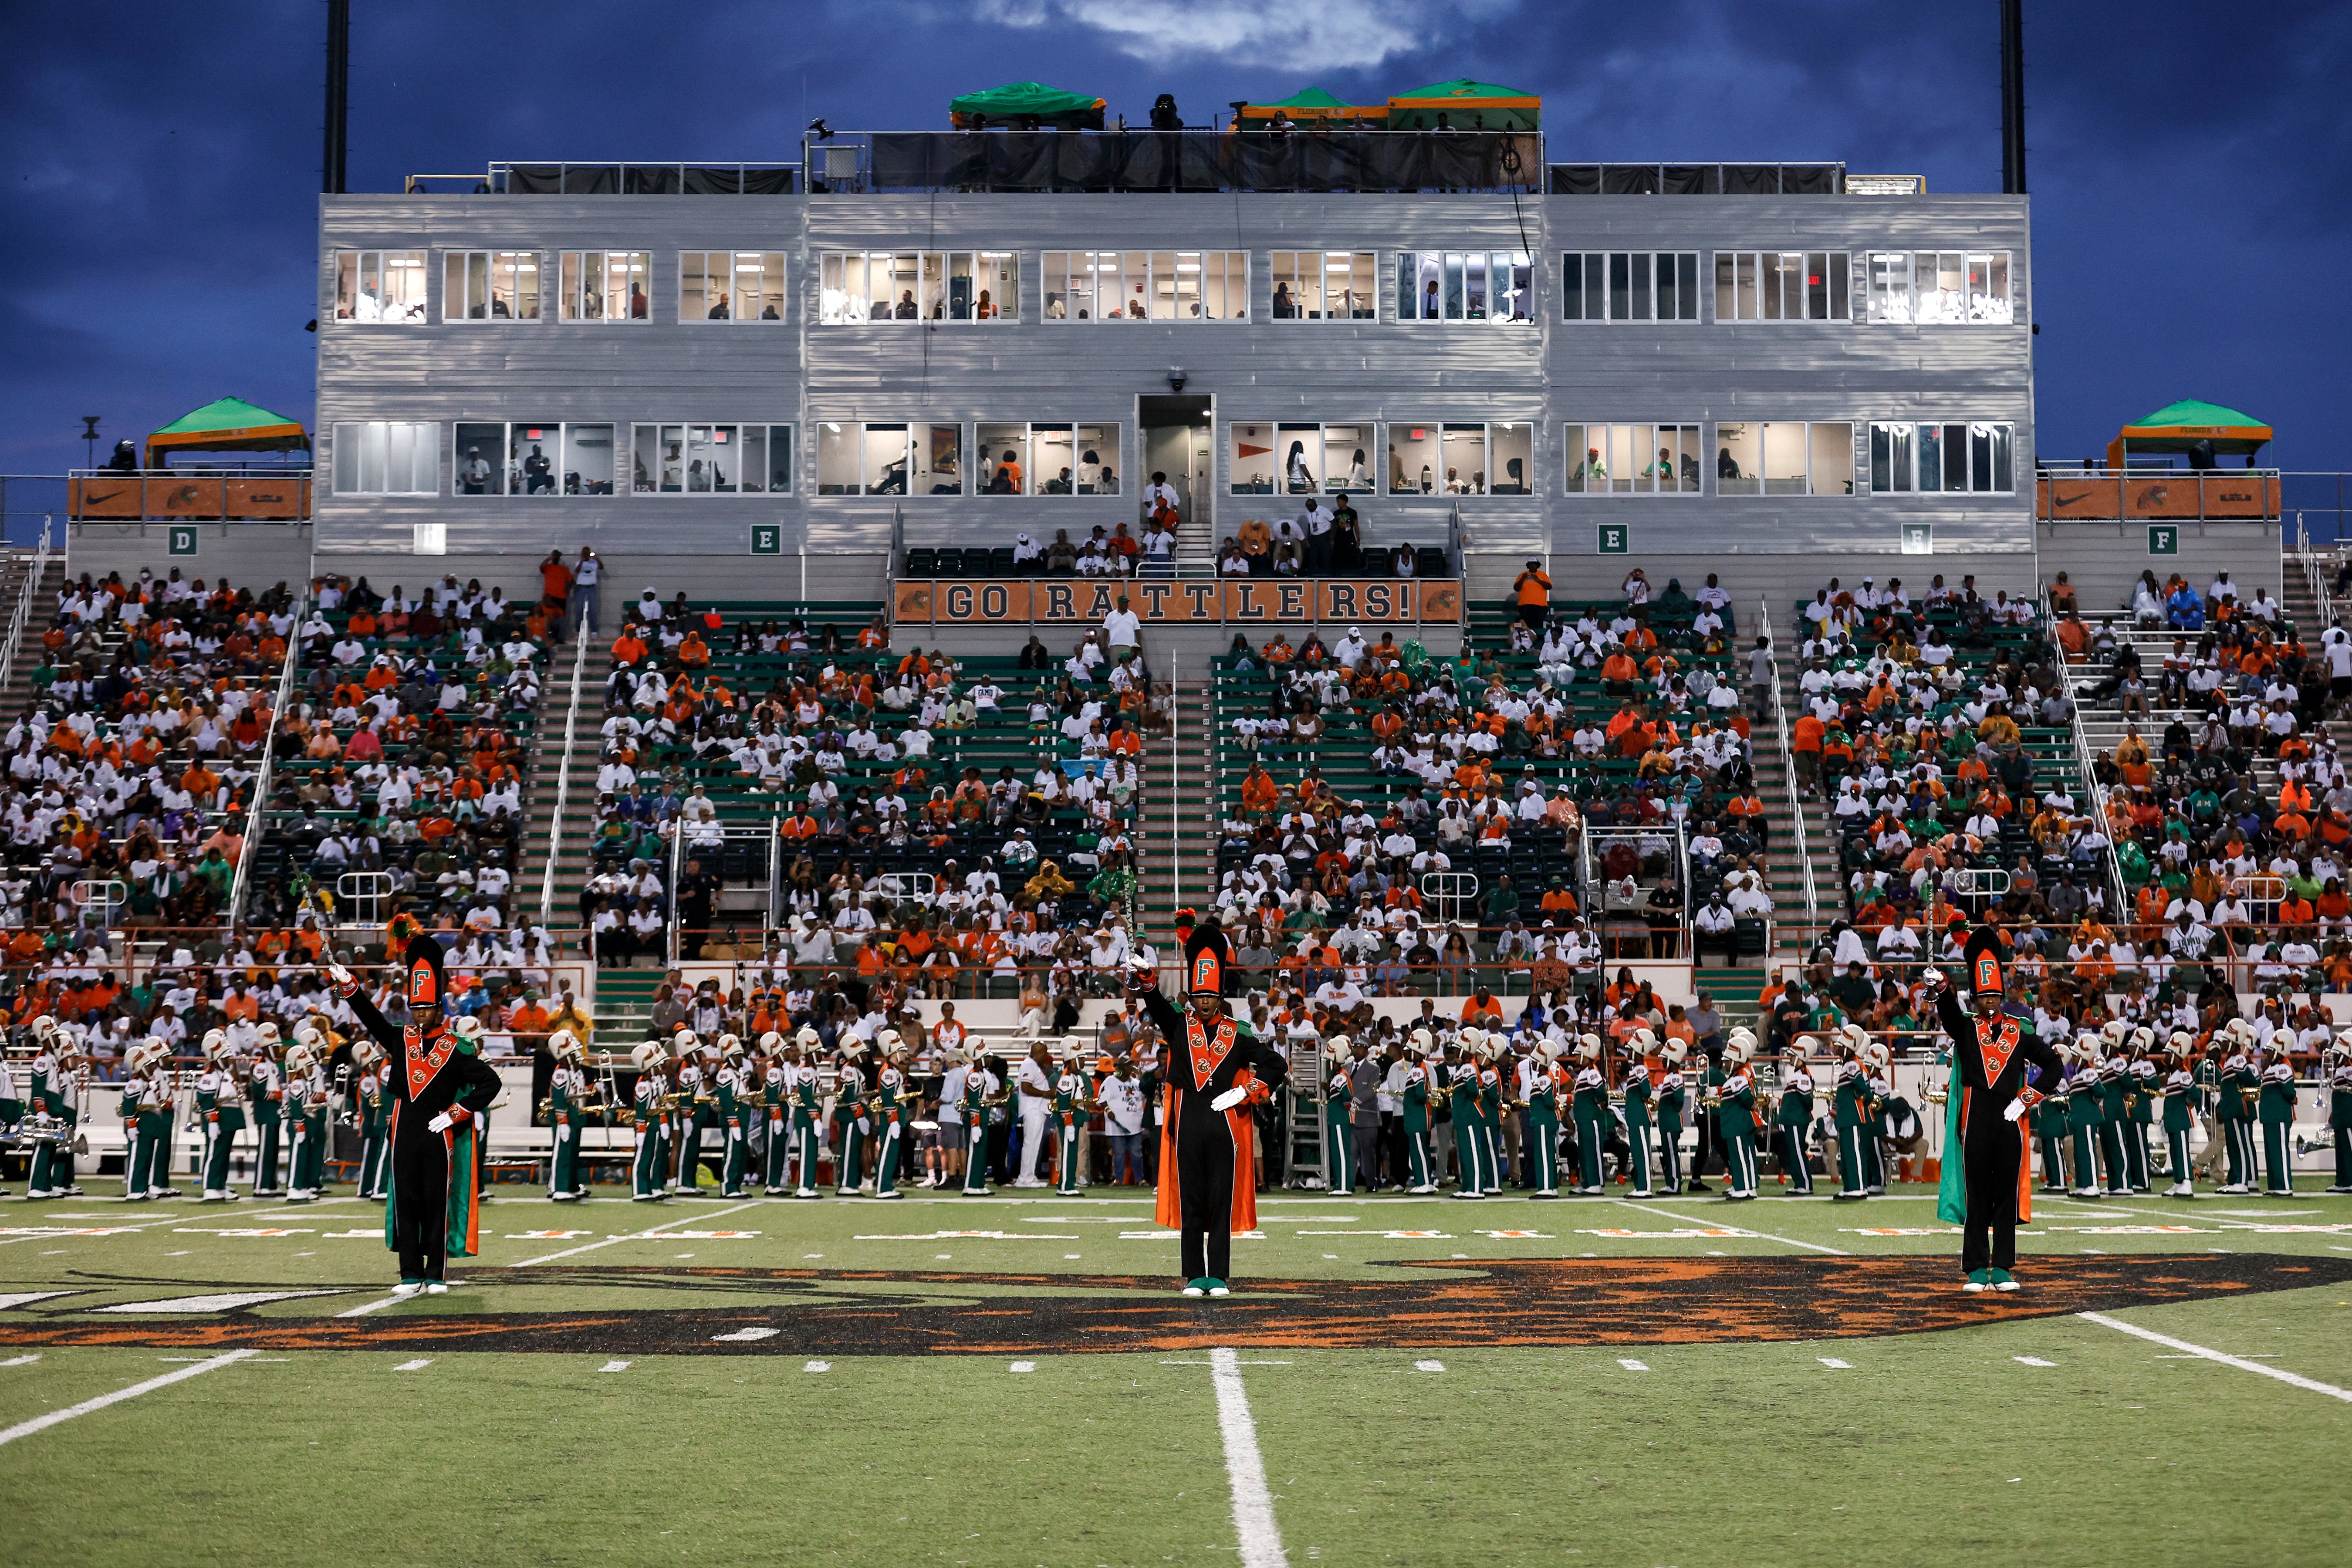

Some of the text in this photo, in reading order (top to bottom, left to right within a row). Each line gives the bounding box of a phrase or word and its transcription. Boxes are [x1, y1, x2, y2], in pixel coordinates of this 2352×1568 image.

[176, 532, 190, 549] D
[759, 531, 772, 548] E
[1607, 531, 1619, 547] E
[2157, 532, 2170, 548] F
[946, 583, 1409, 619] GO RATTLERS!
[2166, 775, 2180, 785] 92
[2200, 767, 2217, 779] 92
[1112, 786, 1130, 795] FAMU
[1196, 958, 1215, 986] F
[1979, 959, 1996, 986] F
[412, 969, 430, 997] F
